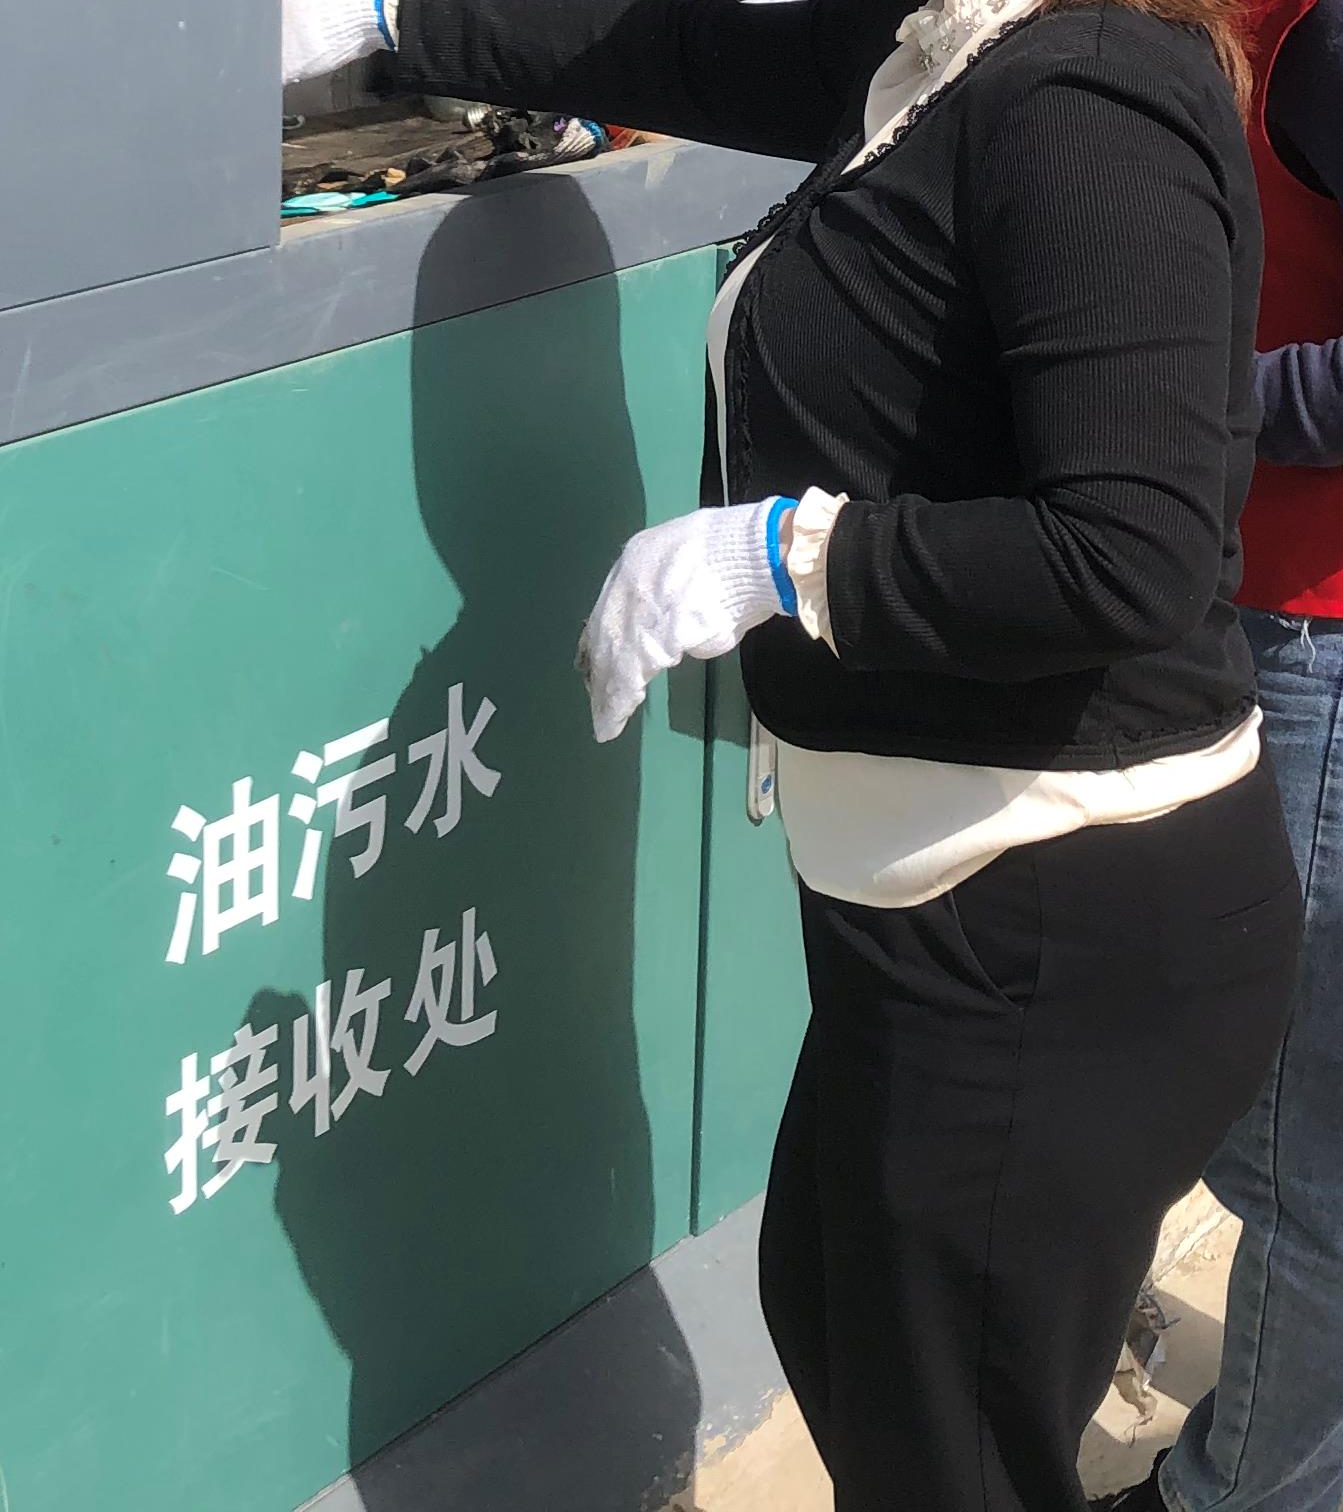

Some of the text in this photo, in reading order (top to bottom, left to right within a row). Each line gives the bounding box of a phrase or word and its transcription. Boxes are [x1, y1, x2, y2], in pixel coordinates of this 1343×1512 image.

[165, 681, 502, 965] 油污水
[164, 906, 498, 1215] 接收处
